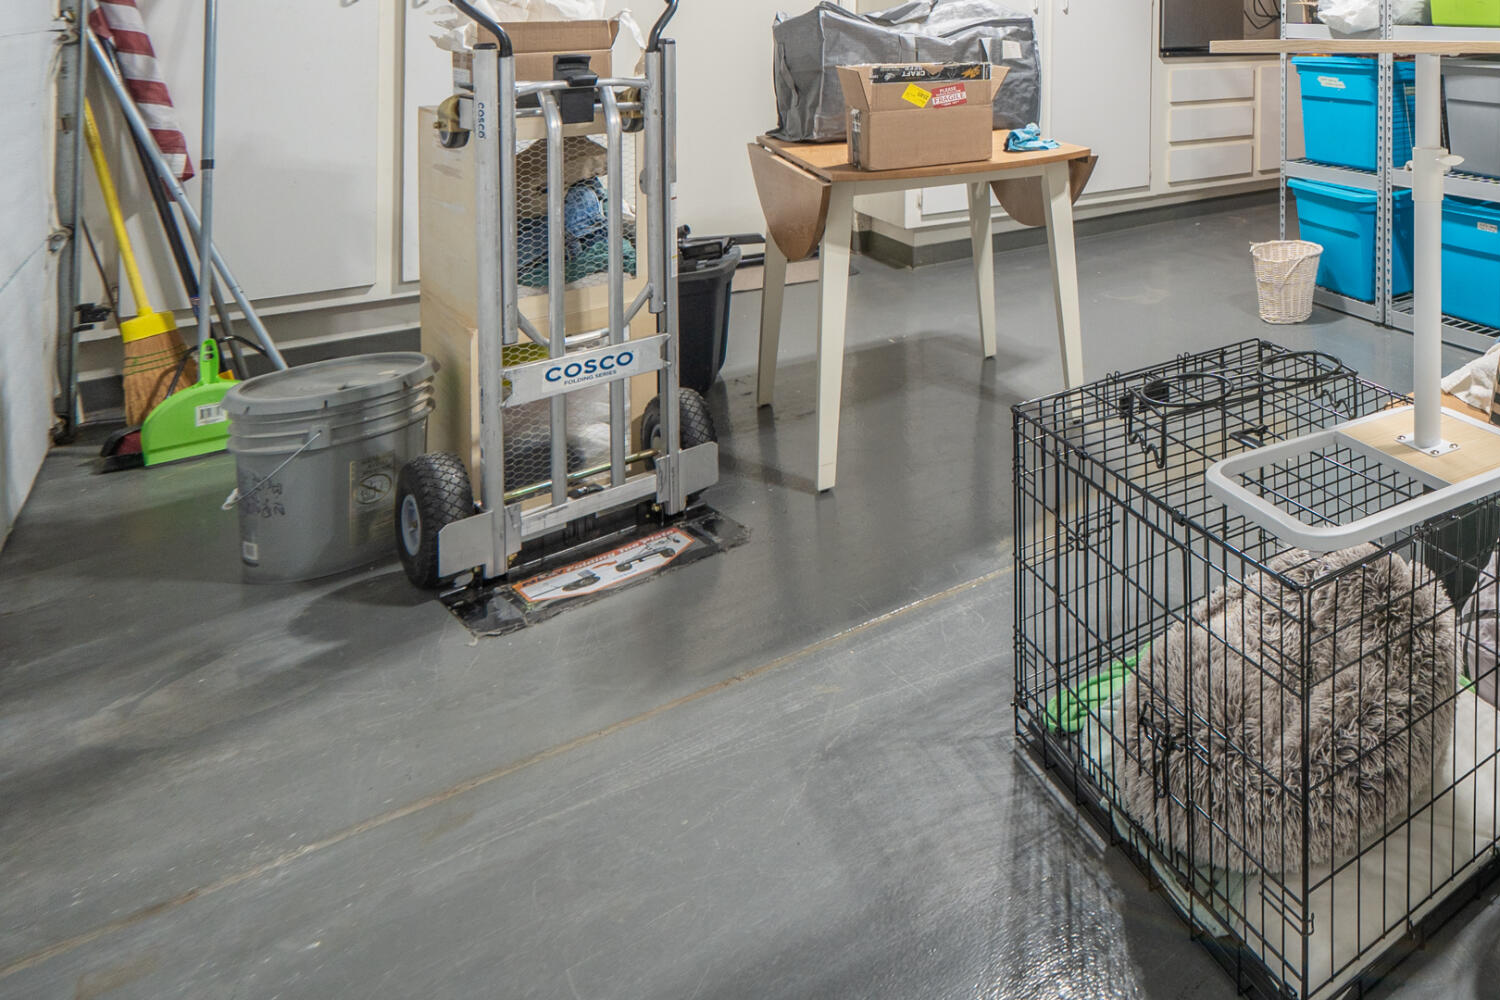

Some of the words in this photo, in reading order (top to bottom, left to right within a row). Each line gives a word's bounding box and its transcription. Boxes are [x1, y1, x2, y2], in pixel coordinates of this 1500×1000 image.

[478, 102, 486, 139] COSCO
[545, 351, 634, 382] COSCO
[564, 375, 594, 386] FOLDING
[595, 369, 617, 379] SERIES
